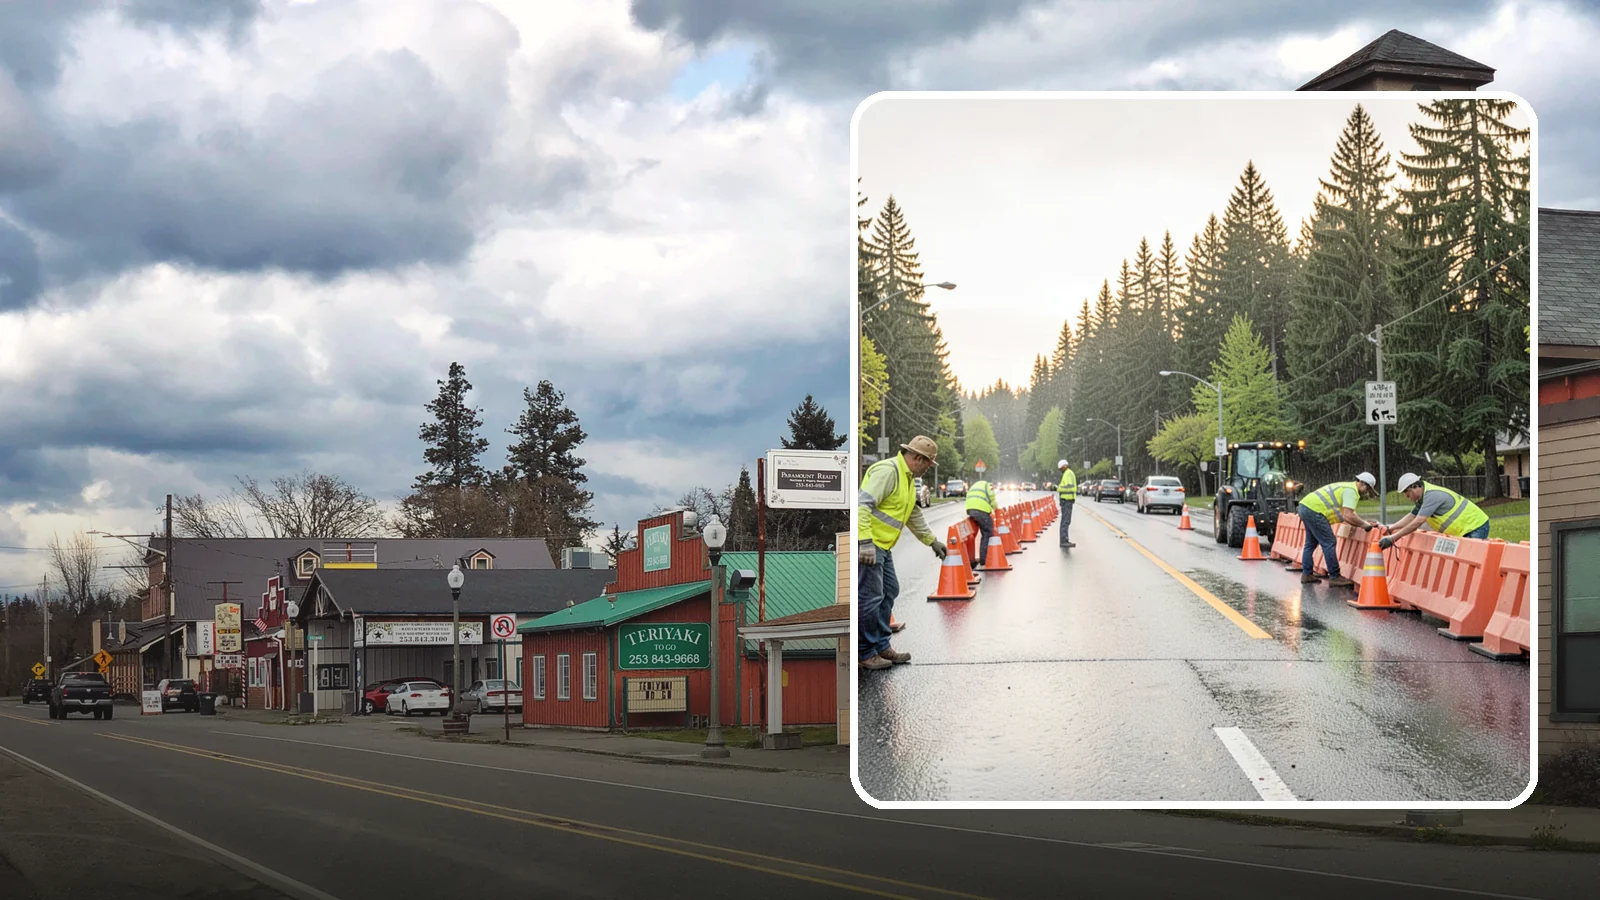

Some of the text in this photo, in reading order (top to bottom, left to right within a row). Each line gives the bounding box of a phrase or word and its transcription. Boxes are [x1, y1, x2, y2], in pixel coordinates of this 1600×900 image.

[781, 471, 839, 480] PARAMOUNT REALTY
[625, 627, 703, 646] TERIYAKI
[629, 653, 700, 664] 253 843-9668
